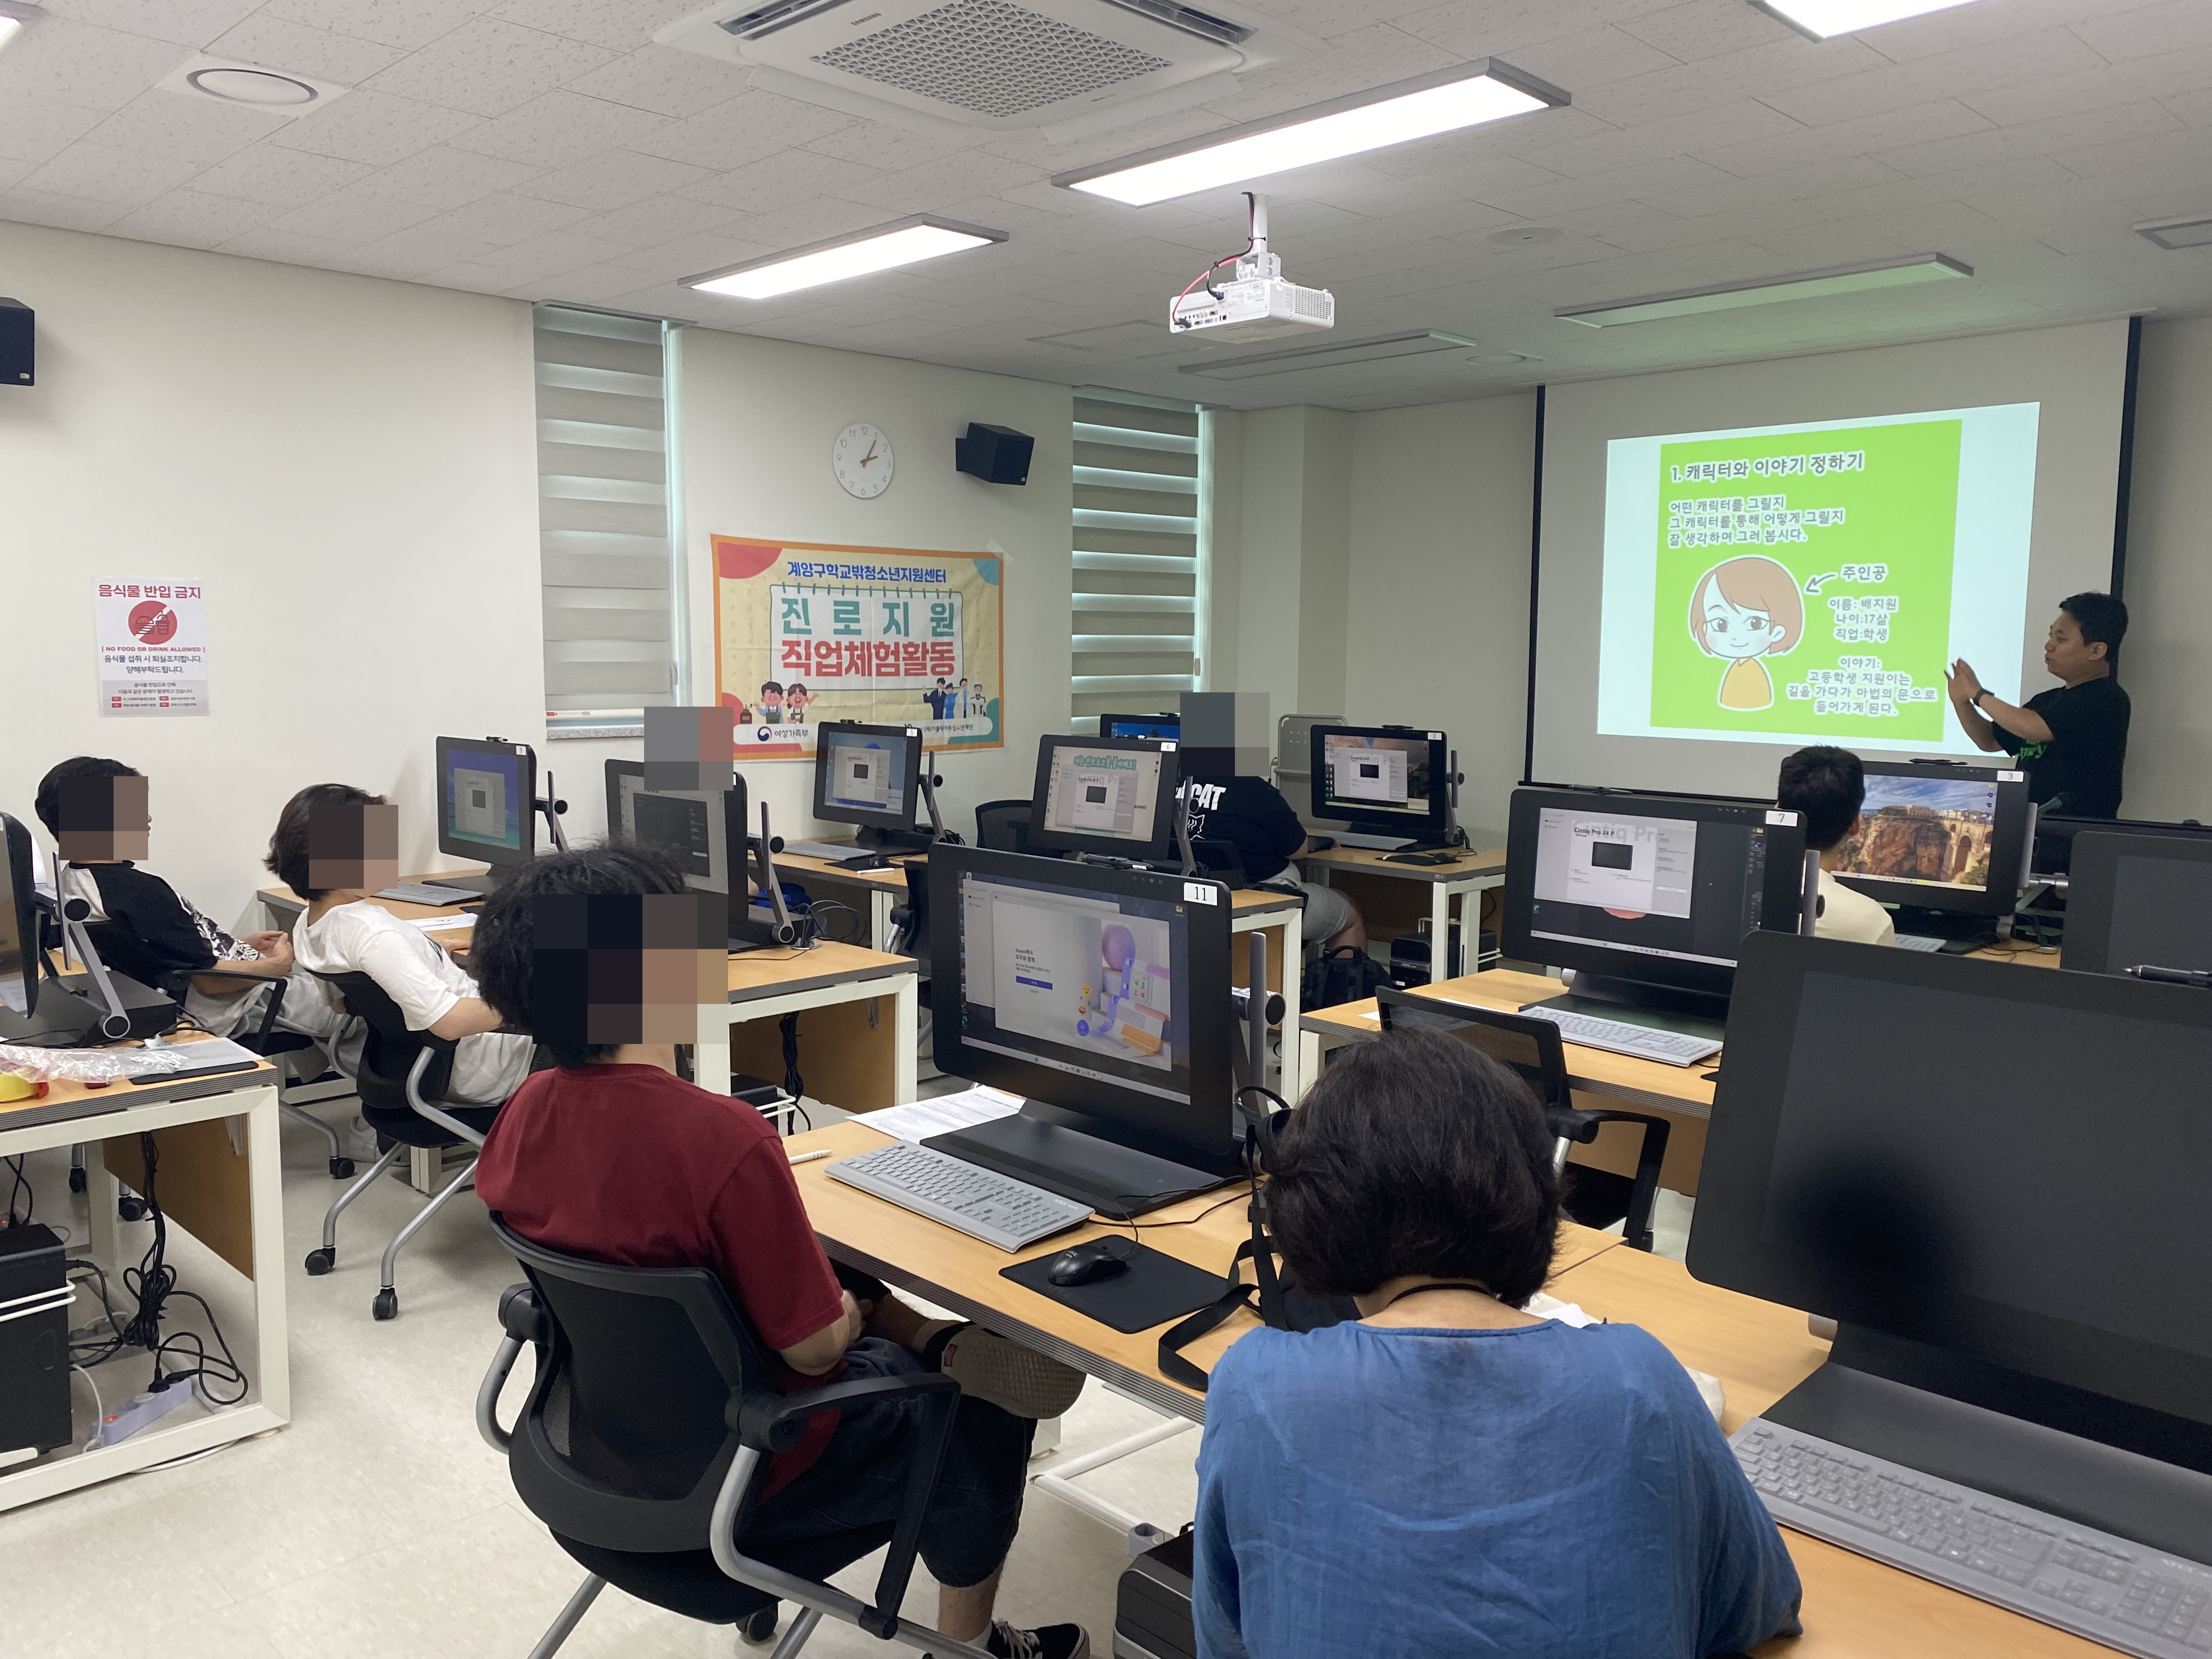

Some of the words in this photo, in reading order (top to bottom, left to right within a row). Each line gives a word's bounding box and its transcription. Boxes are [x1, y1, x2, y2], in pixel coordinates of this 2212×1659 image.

[850, 430, 855, 438] 11
[862, 427, 868, 435] 12
[840, 439, 847, 448] 10
[886, 460, 890, 469] 3
[1672, 467, 1681, 481] 1.
[1687, 461, 1748, 481] 캐릭터와
[1755, 457, 1804, 475] 이야기
[1811, 453, 1863, 474] 정하기
[840, 470, 844, 478] 8
[1671, 501, 1692, 514] 어떤
[1697, 499, 1743, 512] 캐릭터를
[1748, 496, 1784, 509] 그릴지
[1670, 518, 1680, 529] 그
[1685, 515, 1731, 529] 캐릭터를
[1736, 515, 1760, 527] 통해
[1765, 512, 1801, 526] 어떻게
[1805, 510, 1843, 524] 그릴지
[1670, 534, 1680, 546] 잘
[1685, 531, 1733, 545] 생각하며
[1737, 531, 1760, 542] 그려
[1765, 529, 1806, 543] 봅시다.
[787, 561, 946, 583] 계양구학교밖청소년지원센터
[1843, 566, 1886, 580] 주인공
[98, 585, 140, 597] 음식물
[144, 586, 171, 598] 반입
[174, 586, 201, 599] 금지
[1830, 599, 1857, 610] 이름:
[1861, 598, 1896, 610] 배지원
[1837, 614, 1887, 625] 나이:17살
[1836, 629, 1887, 641] 직업:학생
[782, 640, 955, 677] 직업체험활동
[1841, 658, 1880, 668] 이야기:
[1809, 673, 1857, 684] 고등학생
[1862, 673, 1910, 685] 지원이는
[1788, 686, 1810, 697] 길을
[1816, 686, 1852, 697] 가다가
[1857, 688, 1892, 699] 마법의
[1897, 689, 1936, 700] 문으로
[1817, 701, 1864, 713] 들어가게
[1869, 703, 1897, 714] 된다.
[774, 729, 808, 738] 여성가족부
[2006, 772, 2014, 781] 3
[1779, 813, 1785, 823] 7
[1195, 886, 1207, 901] 11
